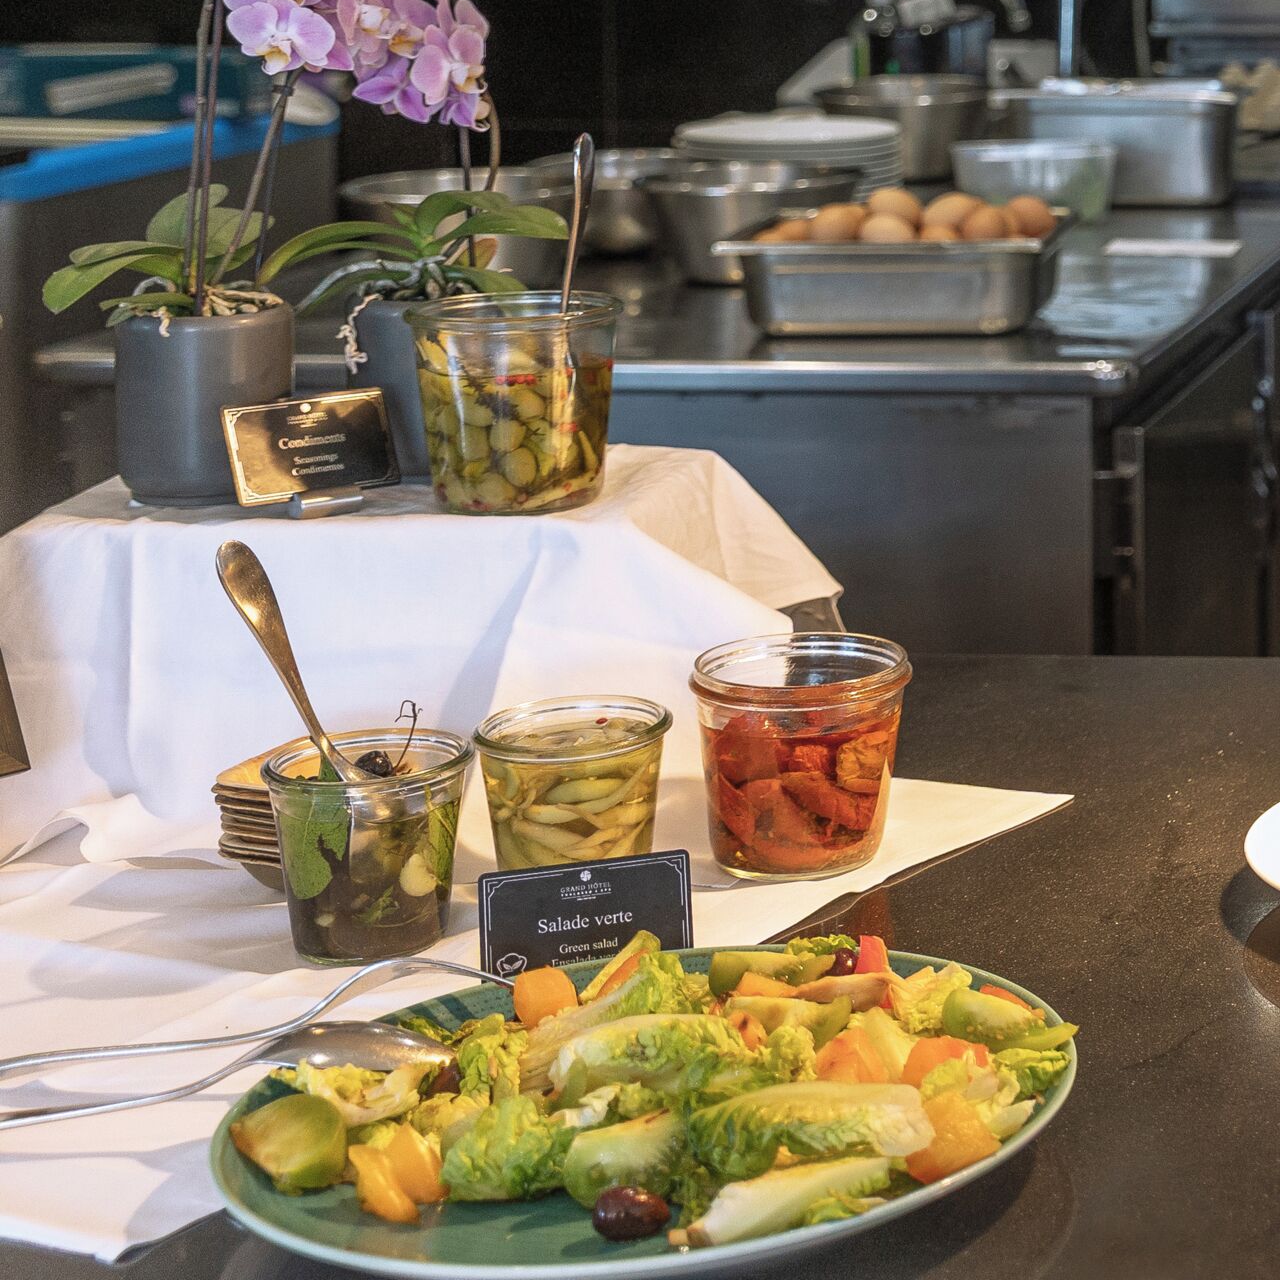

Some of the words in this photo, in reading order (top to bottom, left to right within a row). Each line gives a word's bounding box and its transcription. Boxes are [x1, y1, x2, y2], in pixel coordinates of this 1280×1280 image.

[538, 914, 590, 934] Salade
[595, 911, 633, 926] verte
[559, 943, 590, 954] Green
[592, 937, 619, 949] salad
